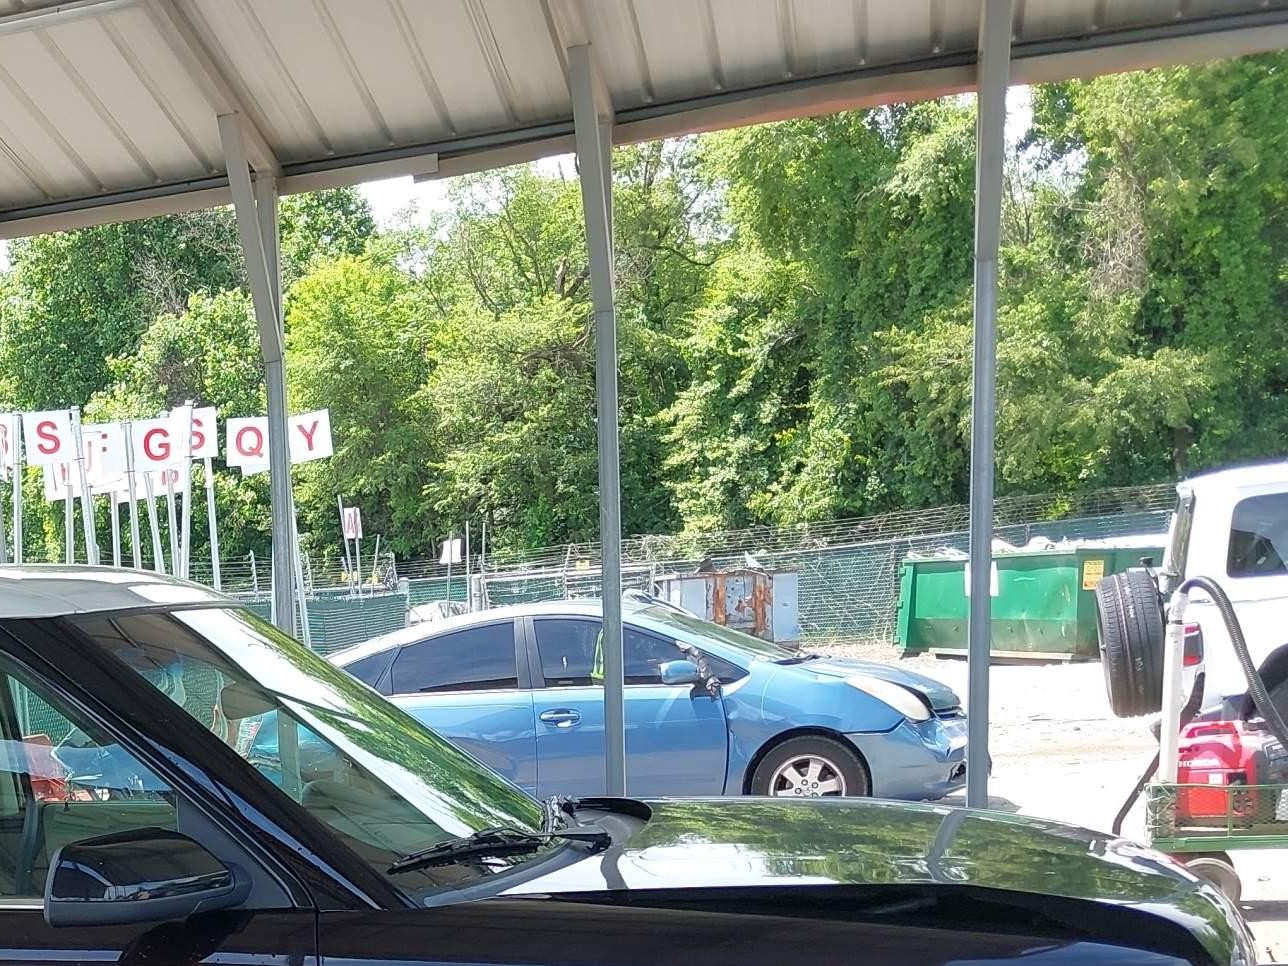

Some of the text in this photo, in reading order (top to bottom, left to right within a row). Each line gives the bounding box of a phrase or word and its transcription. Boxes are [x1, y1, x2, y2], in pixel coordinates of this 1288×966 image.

[37, 421, 61, 454] S
[144, 428, 170, 461] G
[236, 426, 264, 457] Q
[297, 420, 319, 451] Y
